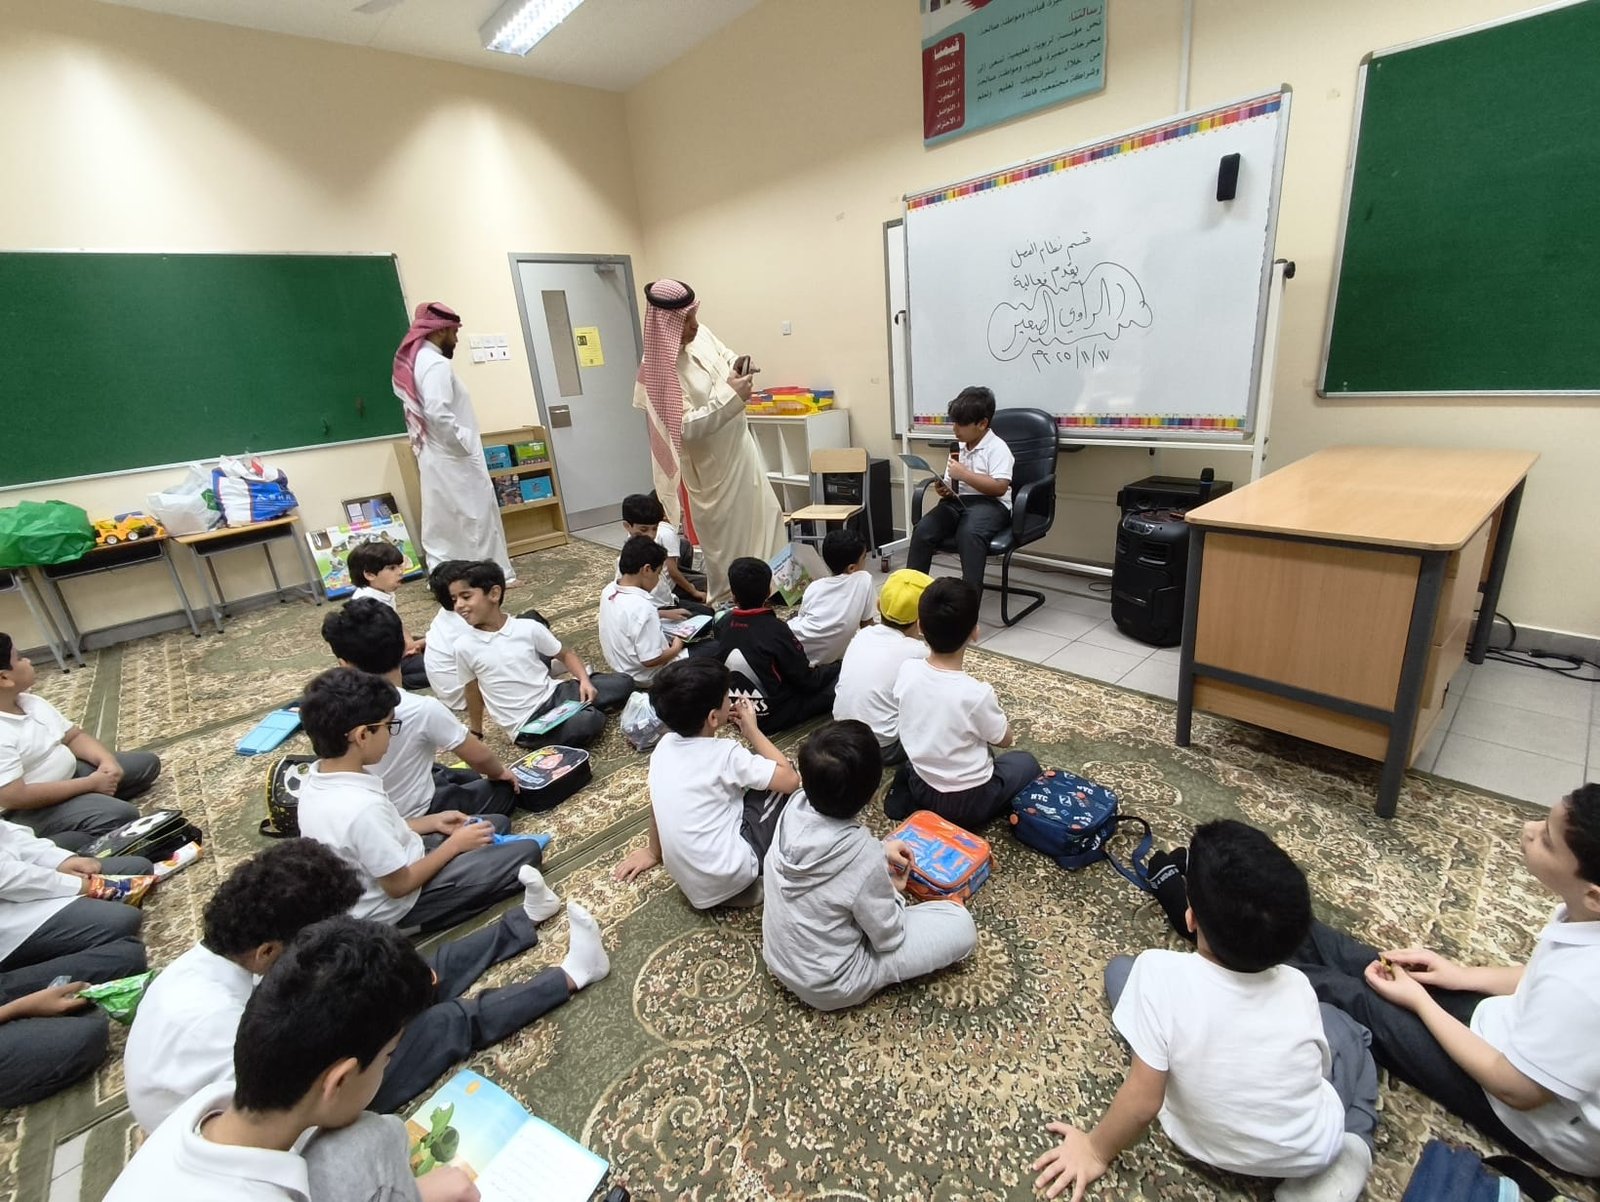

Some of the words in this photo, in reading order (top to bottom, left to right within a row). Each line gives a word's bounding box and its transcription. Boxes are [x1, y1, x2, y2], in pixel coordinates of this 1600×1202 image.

[1040, 236, 1063, 264] نظام
[1066, 231, 1091, 261] قسم
[1013, 272, 1047, 291] فعالية
[1051, 262, 1079, 288] يقدم
[1030, 793, 1049, 803] NYC
[1076, 785, 1094, 795] NYC
